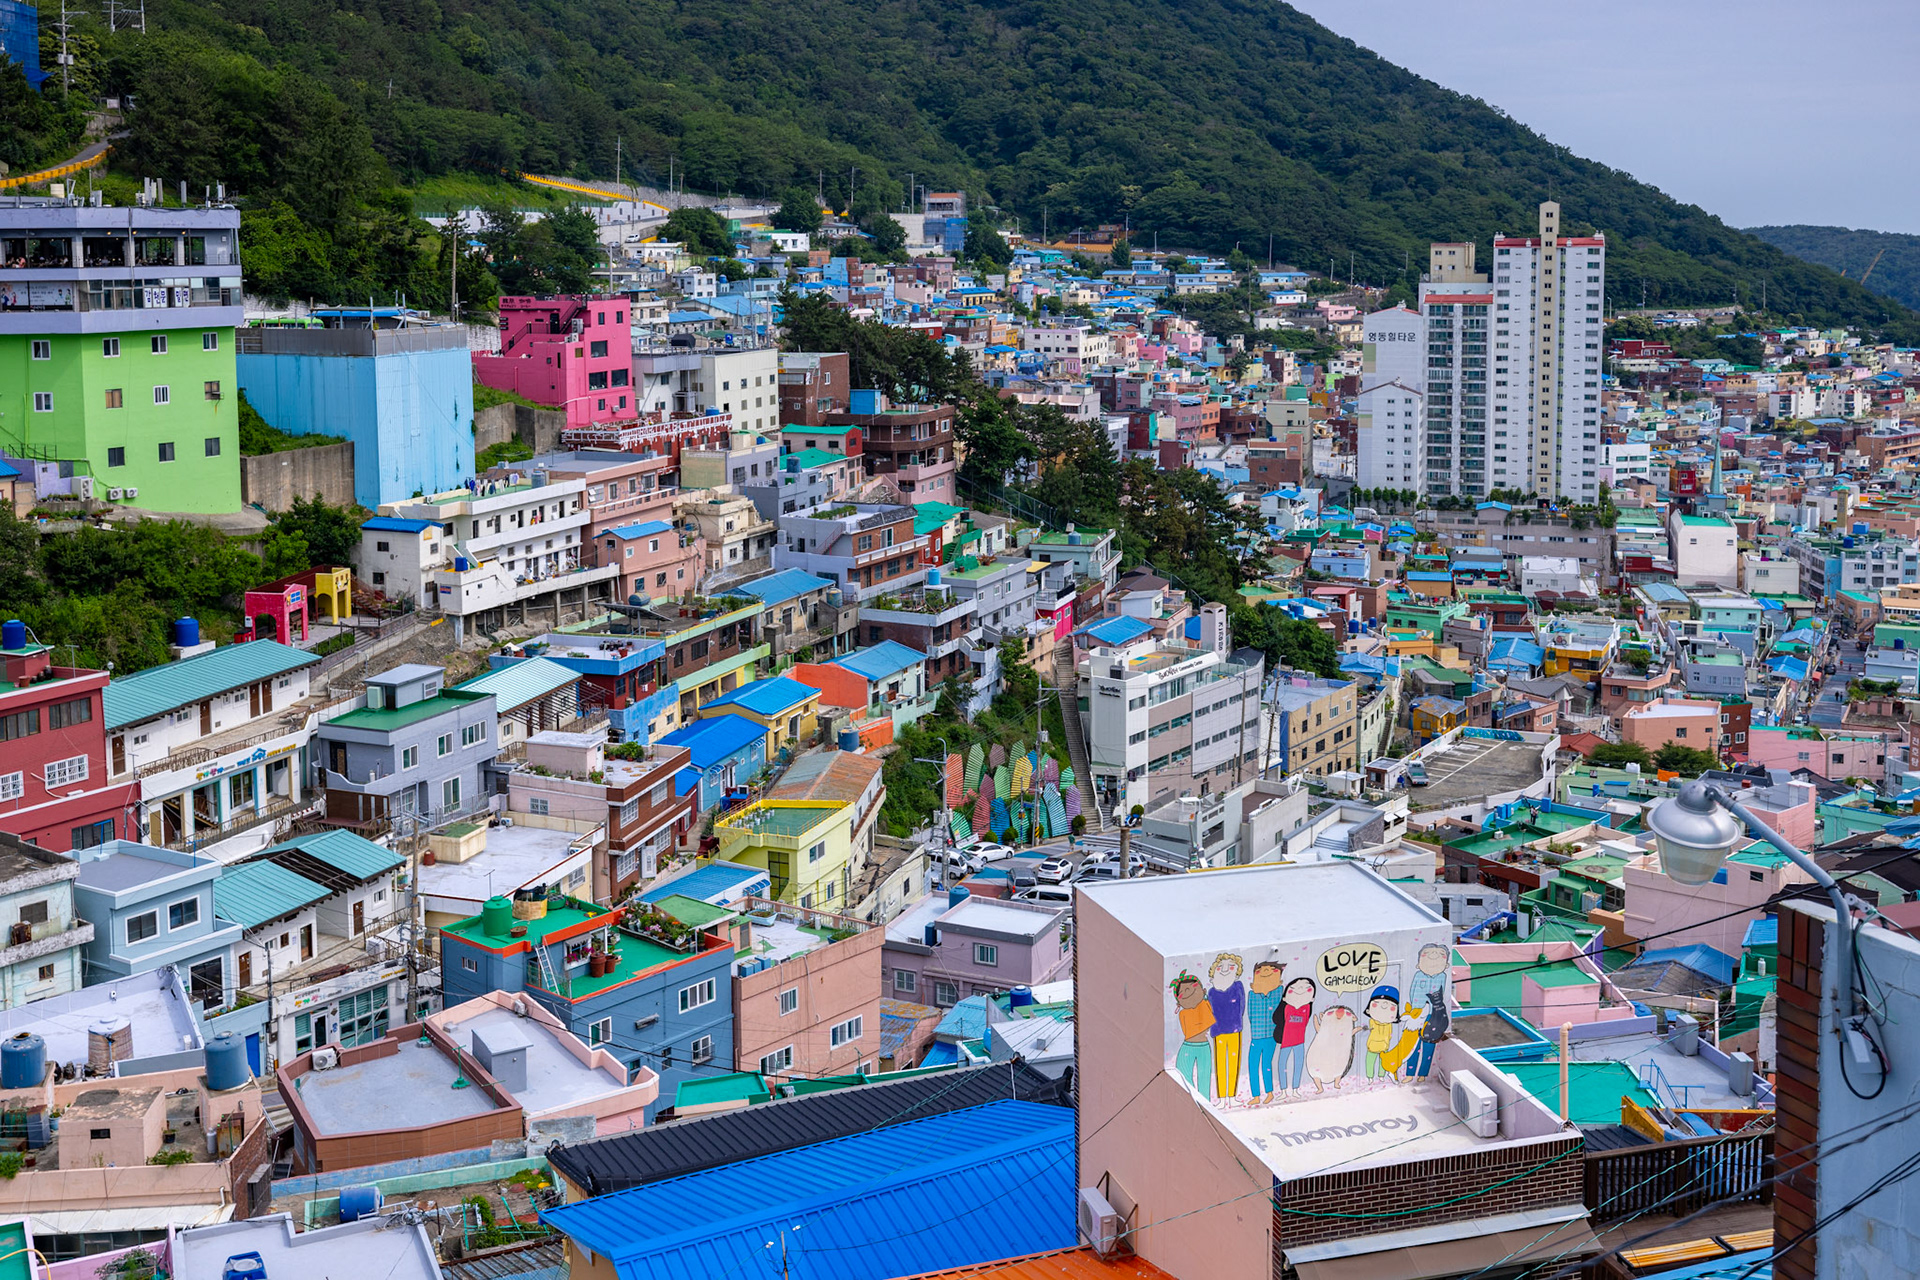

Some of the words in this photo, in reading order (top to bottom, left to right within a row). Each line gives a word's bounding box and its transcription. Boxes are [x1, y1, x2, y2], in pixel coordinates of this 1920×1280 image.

[1368, 332, 1416, 342] 영동힐타운
[1324, 950, 1381, 973] LOVE
[1324, 974, 1378, 987] GAMCHEON
[1270, 1114, 1419, 1148] momoroy
